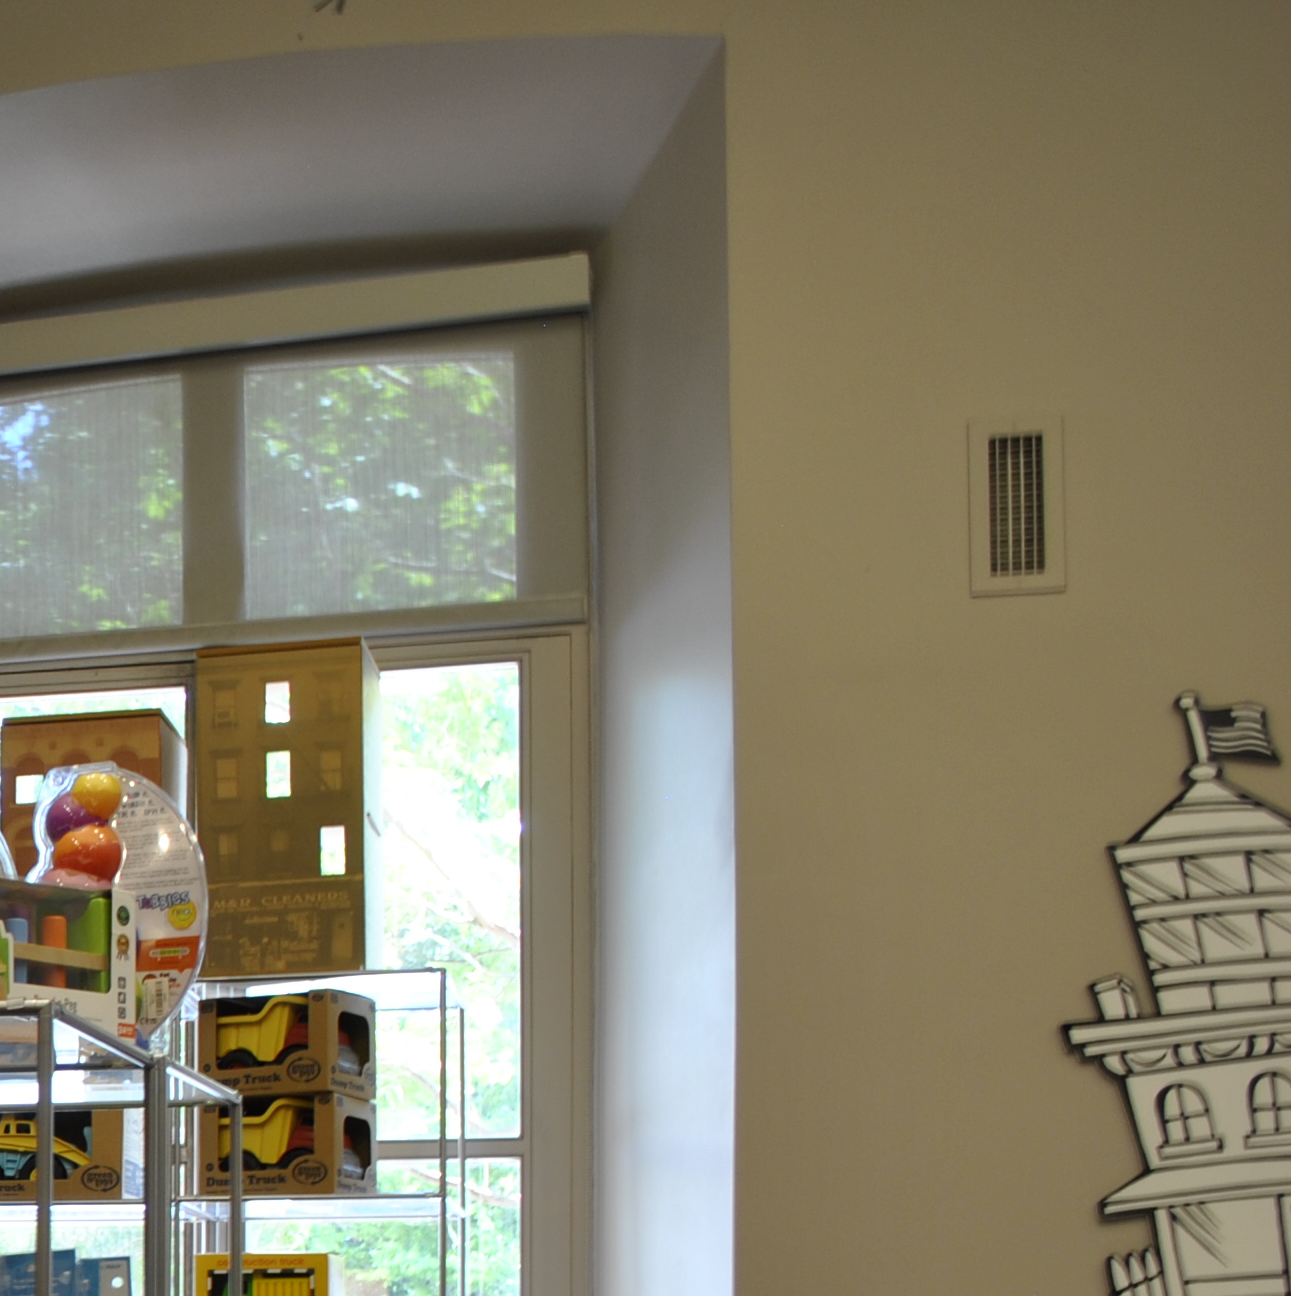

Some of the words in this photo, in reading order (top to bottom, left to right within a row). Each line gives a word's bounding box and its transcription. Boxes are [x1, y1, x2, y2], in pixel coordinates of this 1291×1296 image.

[244, 1073, 281, 1084] Truck
[86, 1171, 113, 1183] green
[247, 1174, 287, 1185] Truck
[216, 1258, 277, 1267] coruction
[280, 1257, 305, 1266] truck
